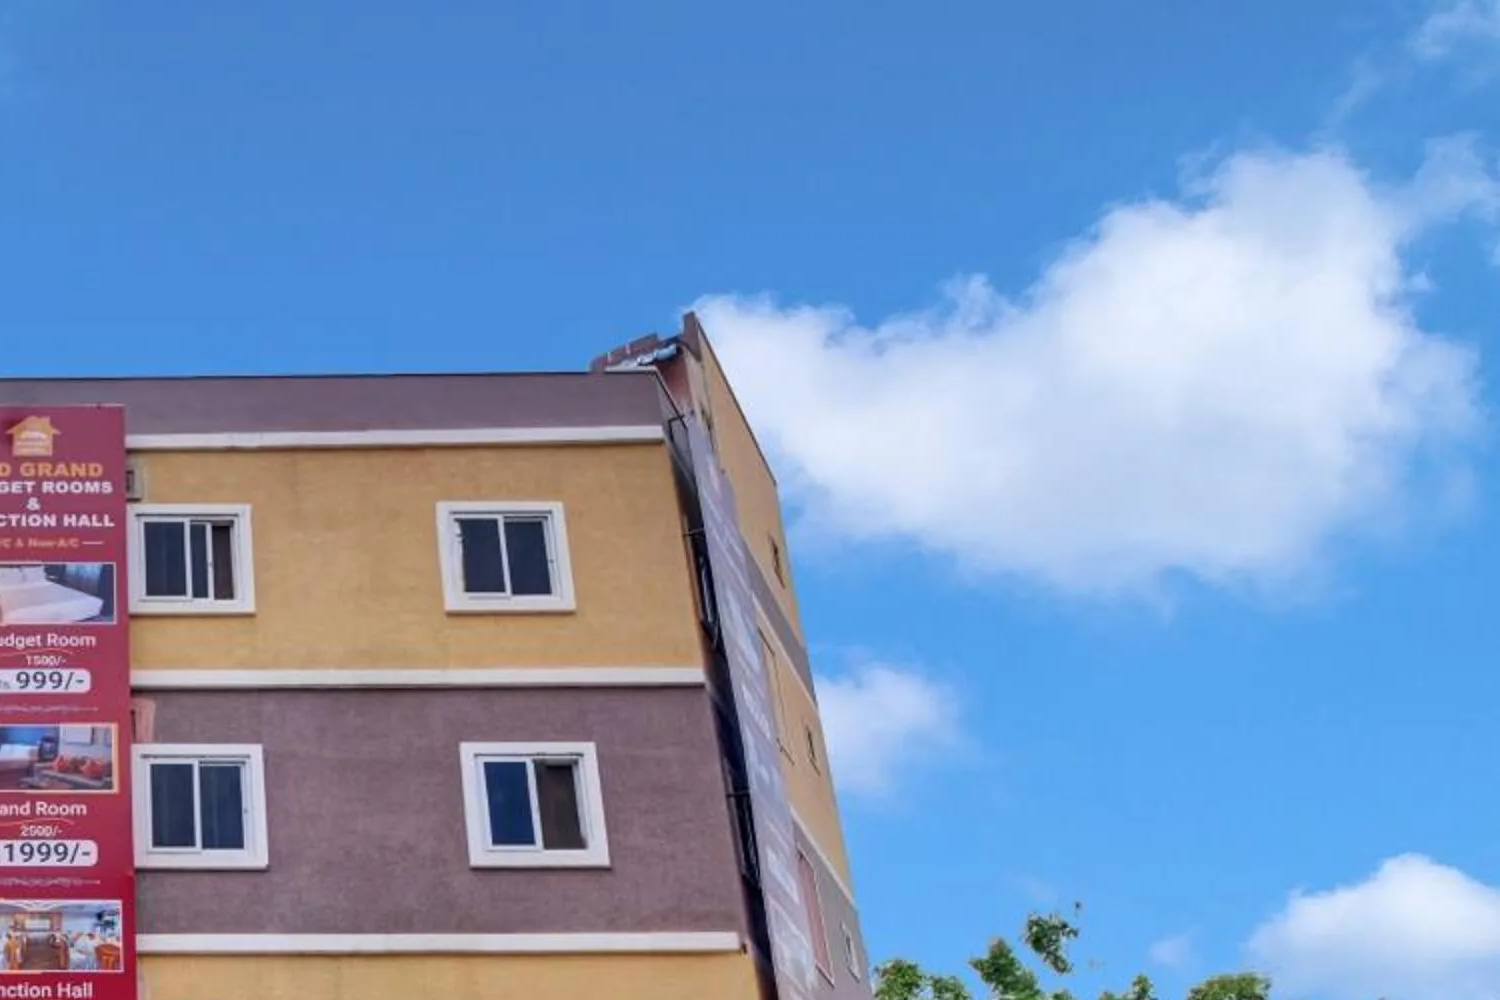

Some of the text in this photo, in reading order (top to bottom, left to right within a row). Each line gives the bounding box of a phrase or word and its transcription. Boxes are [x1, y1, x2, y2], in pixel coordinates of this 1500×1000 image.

[20, 462, 103, 477] GRAND
[42, 481, 113, 493] ROOMS
[26, 497, 41, 510] &
[63, 514, 115, 527] HALL
[47, 633, 97, 647] Room
[16, 671, 85, 690] 999/-
[35, 802, 87, 816] Room
[4, 842, 91, 864] 1999/-
[57, 982, 93, 998] Hall
